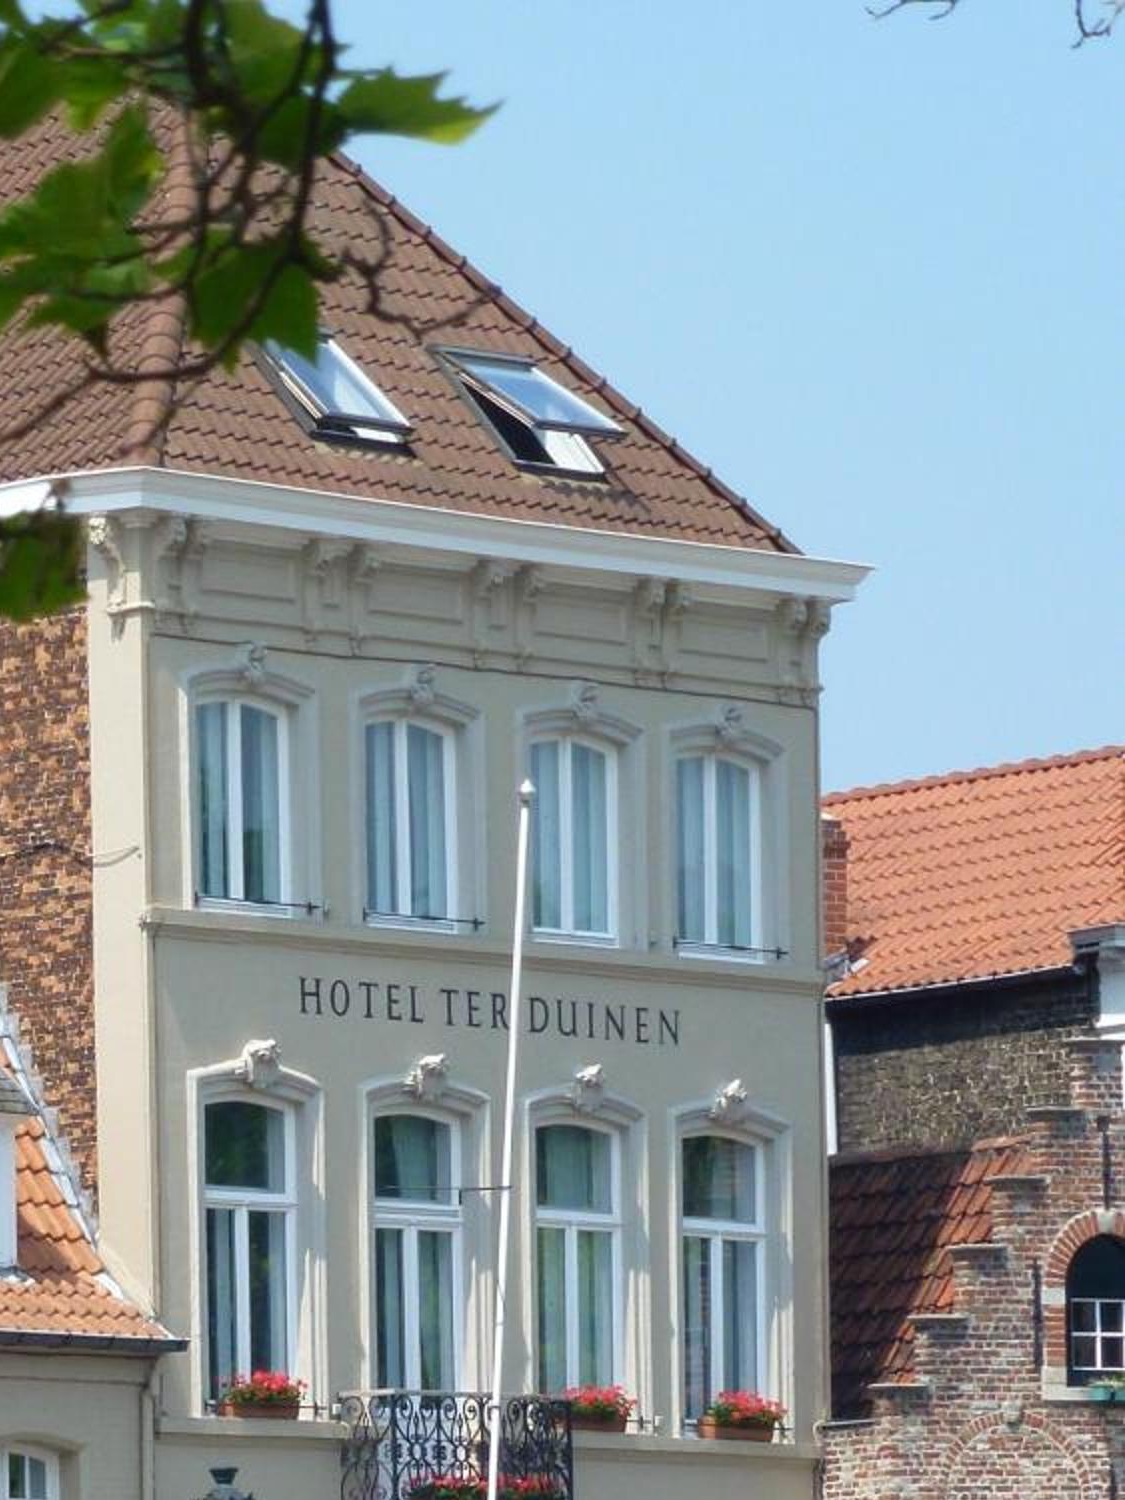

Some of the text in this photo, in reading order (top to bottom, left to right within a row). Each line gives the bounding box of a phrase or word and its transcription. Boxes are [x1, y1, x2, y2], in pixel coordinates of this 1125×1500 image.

[298, 976, 681, 1046] HOTEL TER DUINEN
